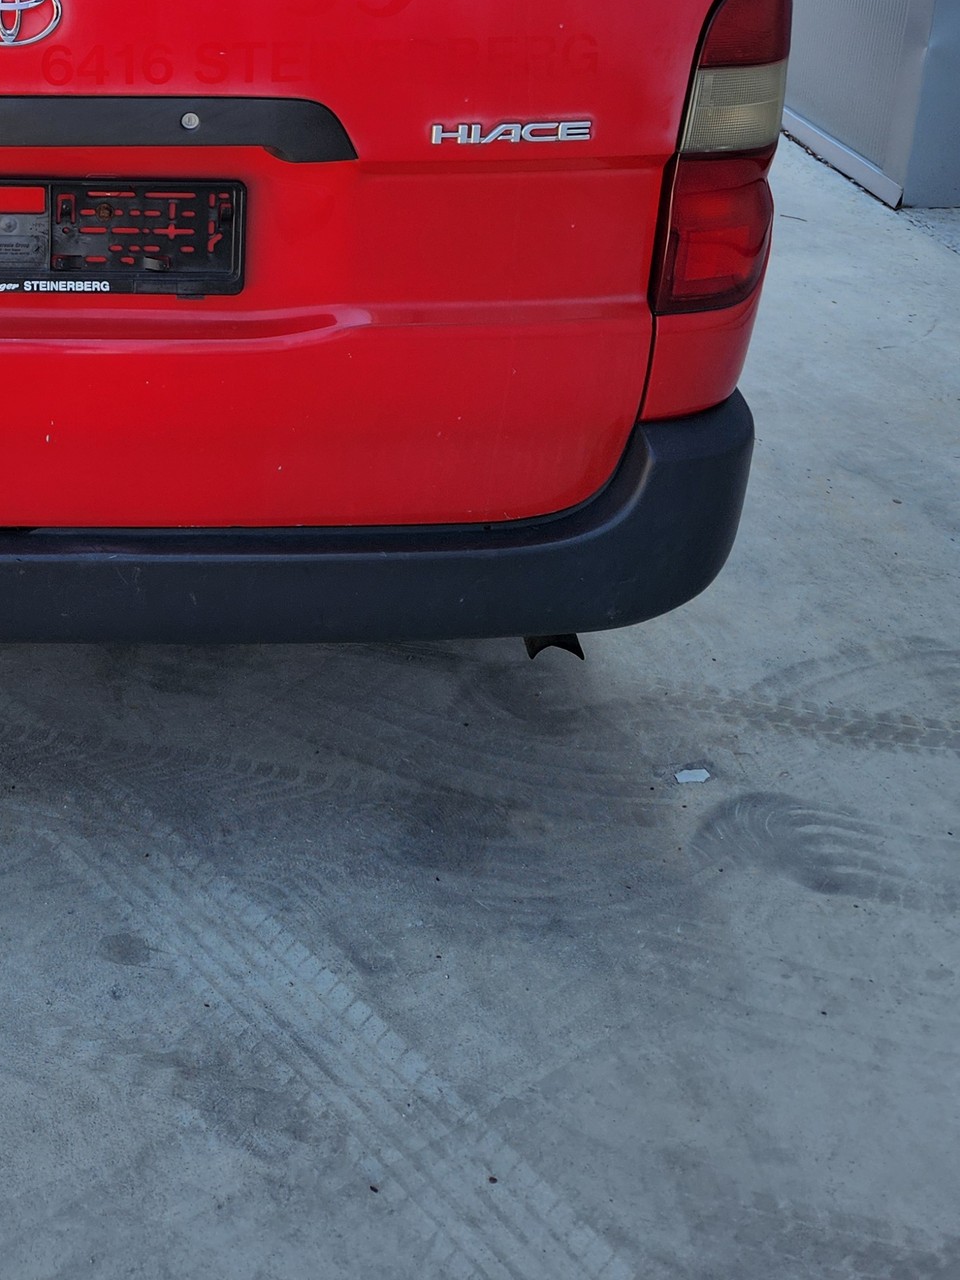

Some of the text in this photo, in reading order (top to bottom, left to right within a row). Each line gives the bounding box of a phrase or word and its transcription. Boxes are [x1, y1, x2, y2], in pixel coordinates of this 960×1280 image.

[40, 42, 175, 86] 6416
[431, 120, 592, 145] HIACE
[23, 280, 110, 292] STEINERBERG
